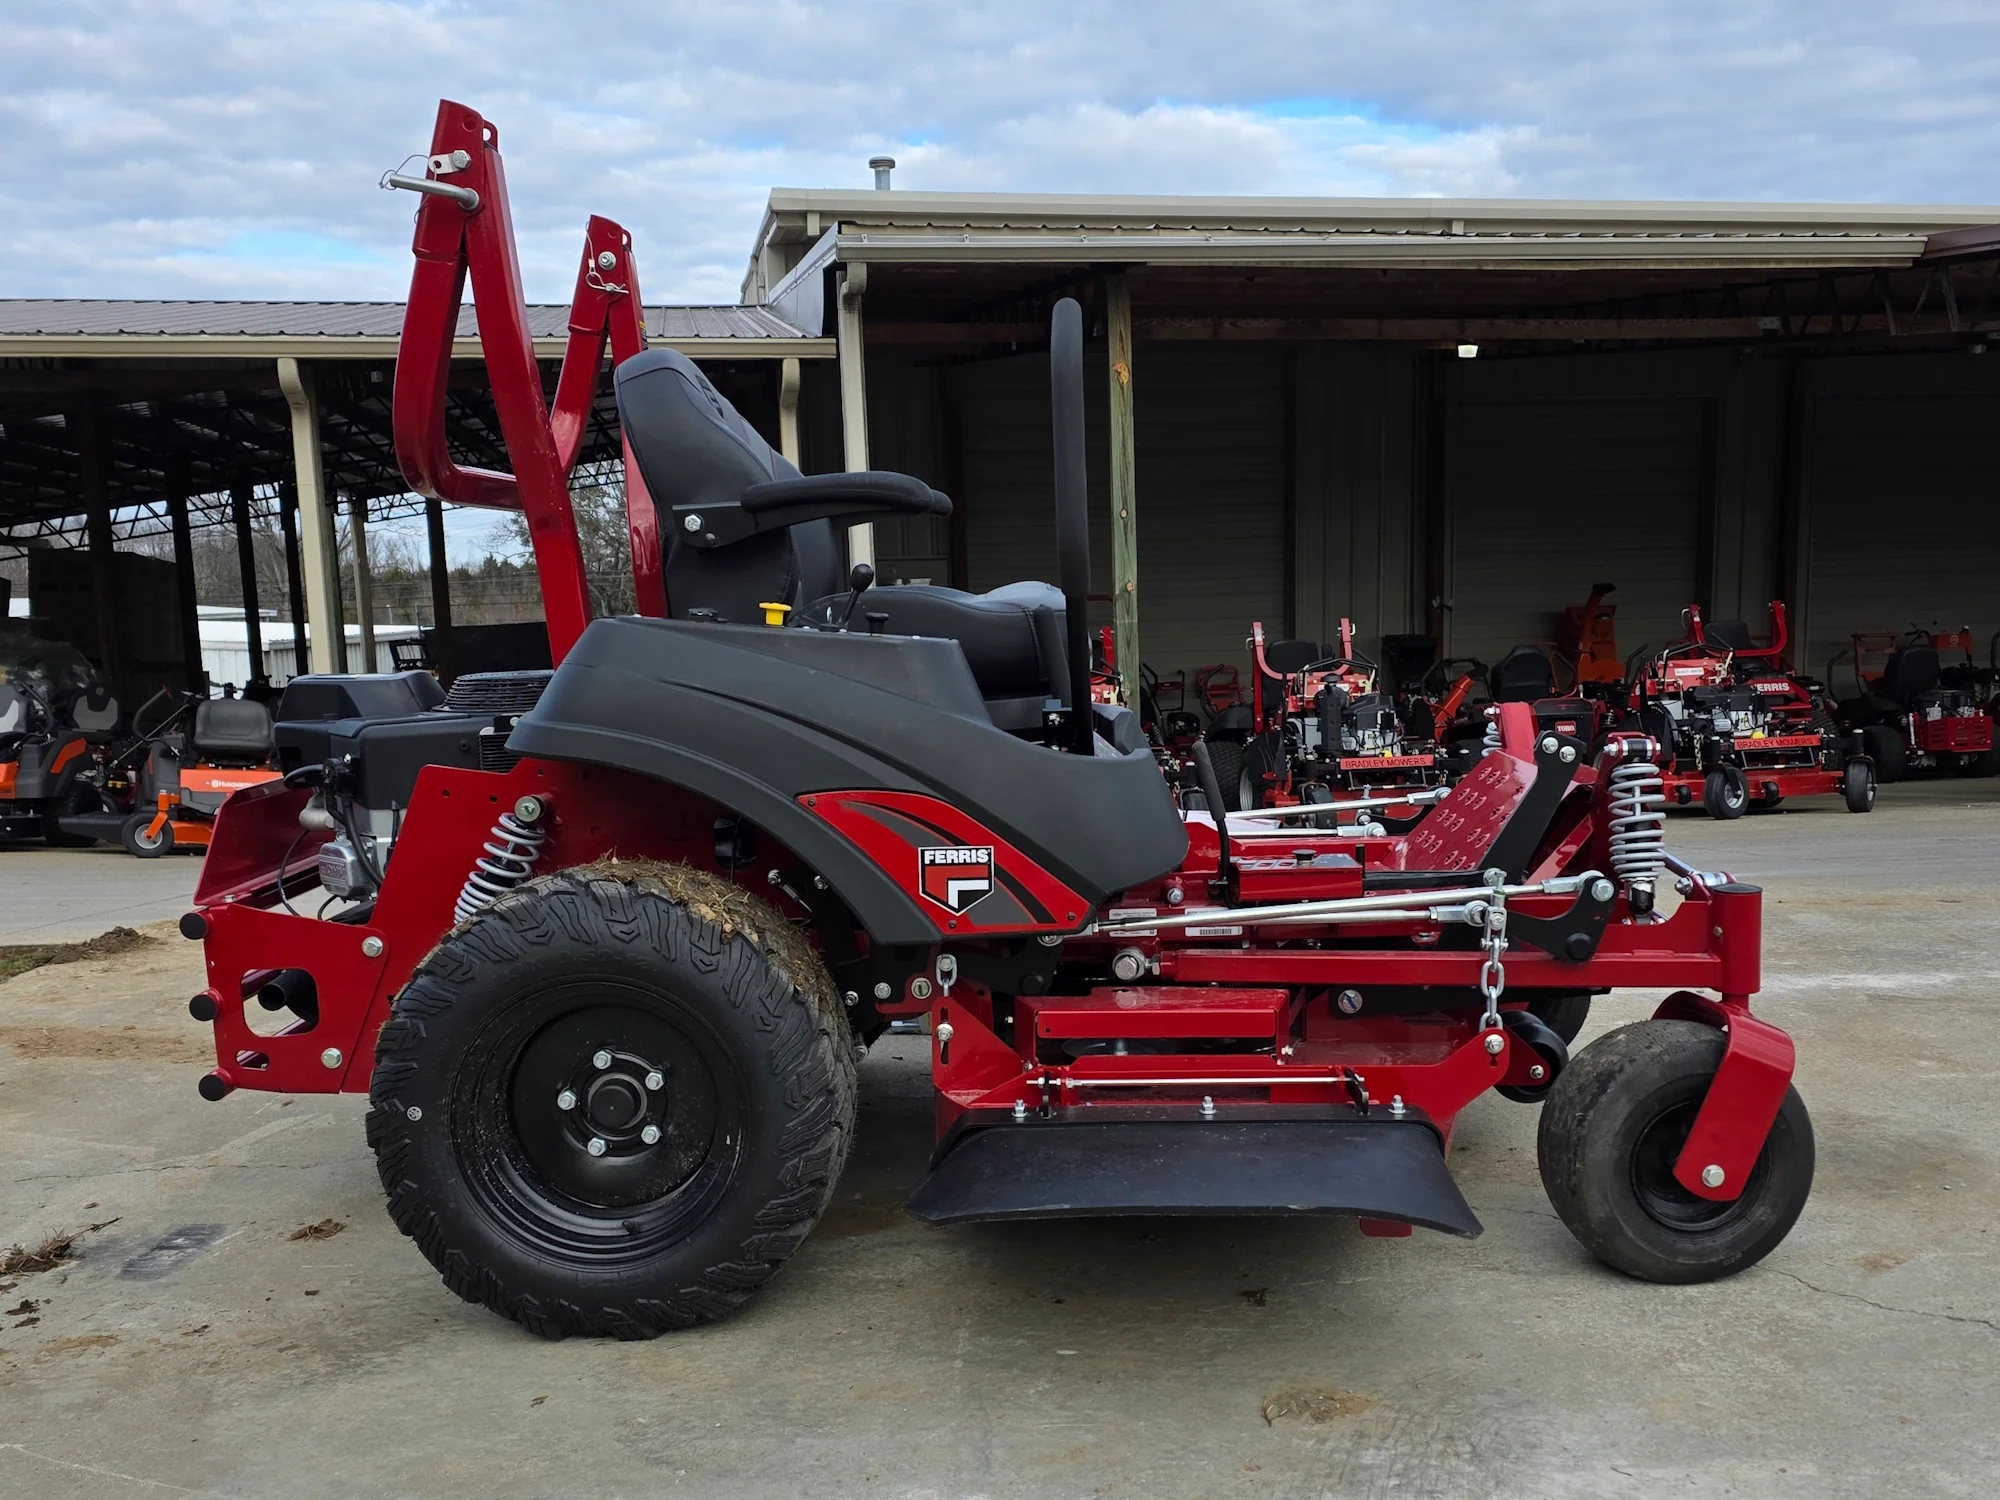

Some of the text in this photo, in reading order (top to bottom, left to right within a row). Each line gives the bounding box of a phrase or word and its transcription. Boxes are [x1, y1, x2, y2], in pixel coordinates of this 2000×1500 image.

[1556, 724, 1575, 732] TORO
[1736, 737, 1813, 749] BRADLEY MOWERS
[1345, 757, 1427, 769] BRADLEY MOWERS
[924, 848, 989, 865] FERRIS
